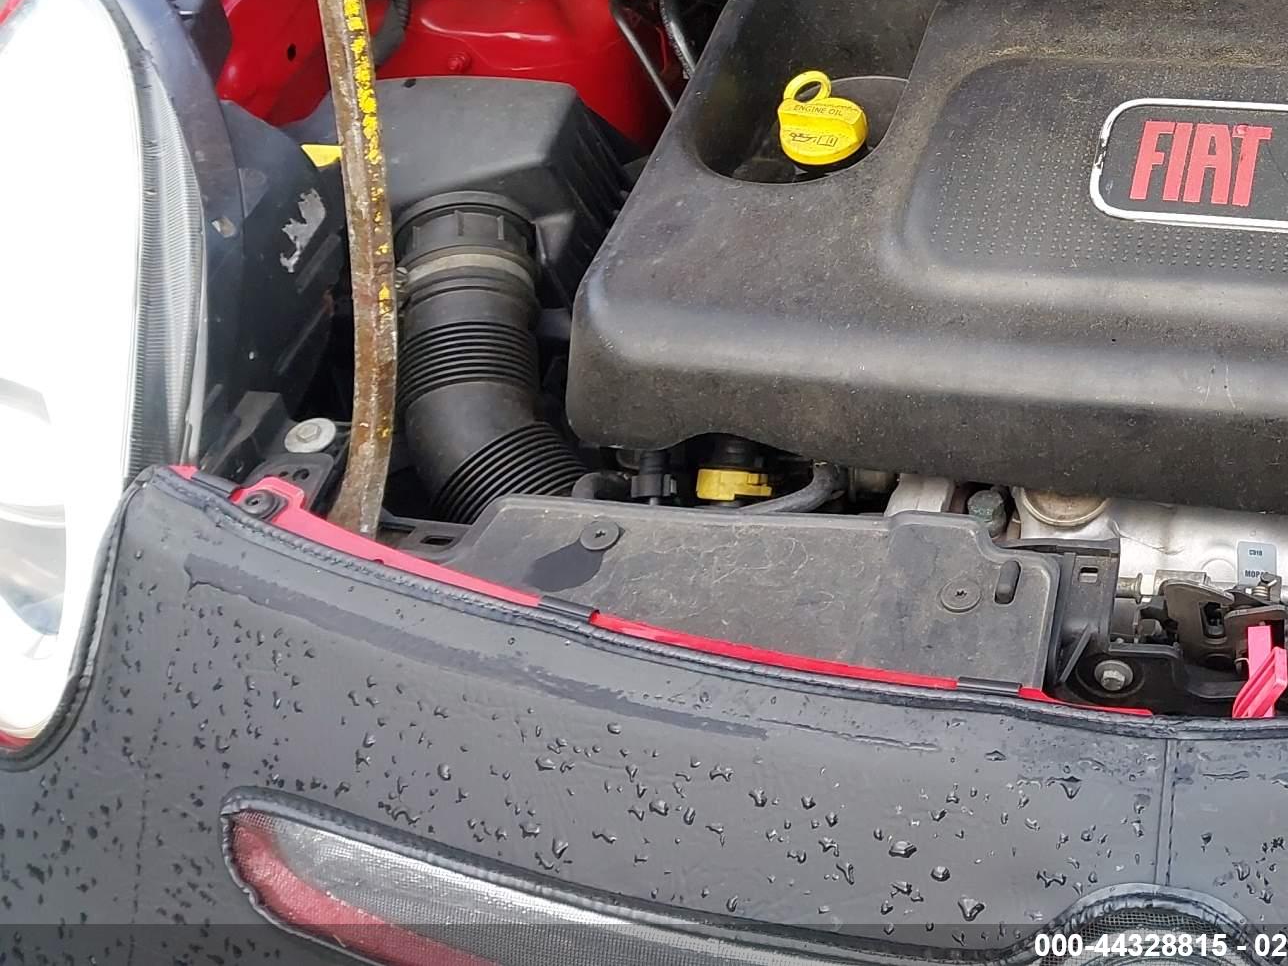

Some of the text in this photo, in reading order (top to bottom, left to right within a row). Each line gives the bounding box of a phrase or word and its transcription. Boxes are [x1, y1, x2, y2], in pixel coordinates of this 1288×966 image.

[794, 104, 843, 116] ENGINE OIL
[1129, 120, 1273, 206] FIAT
[1245, 570, 1269, 578] MOP
